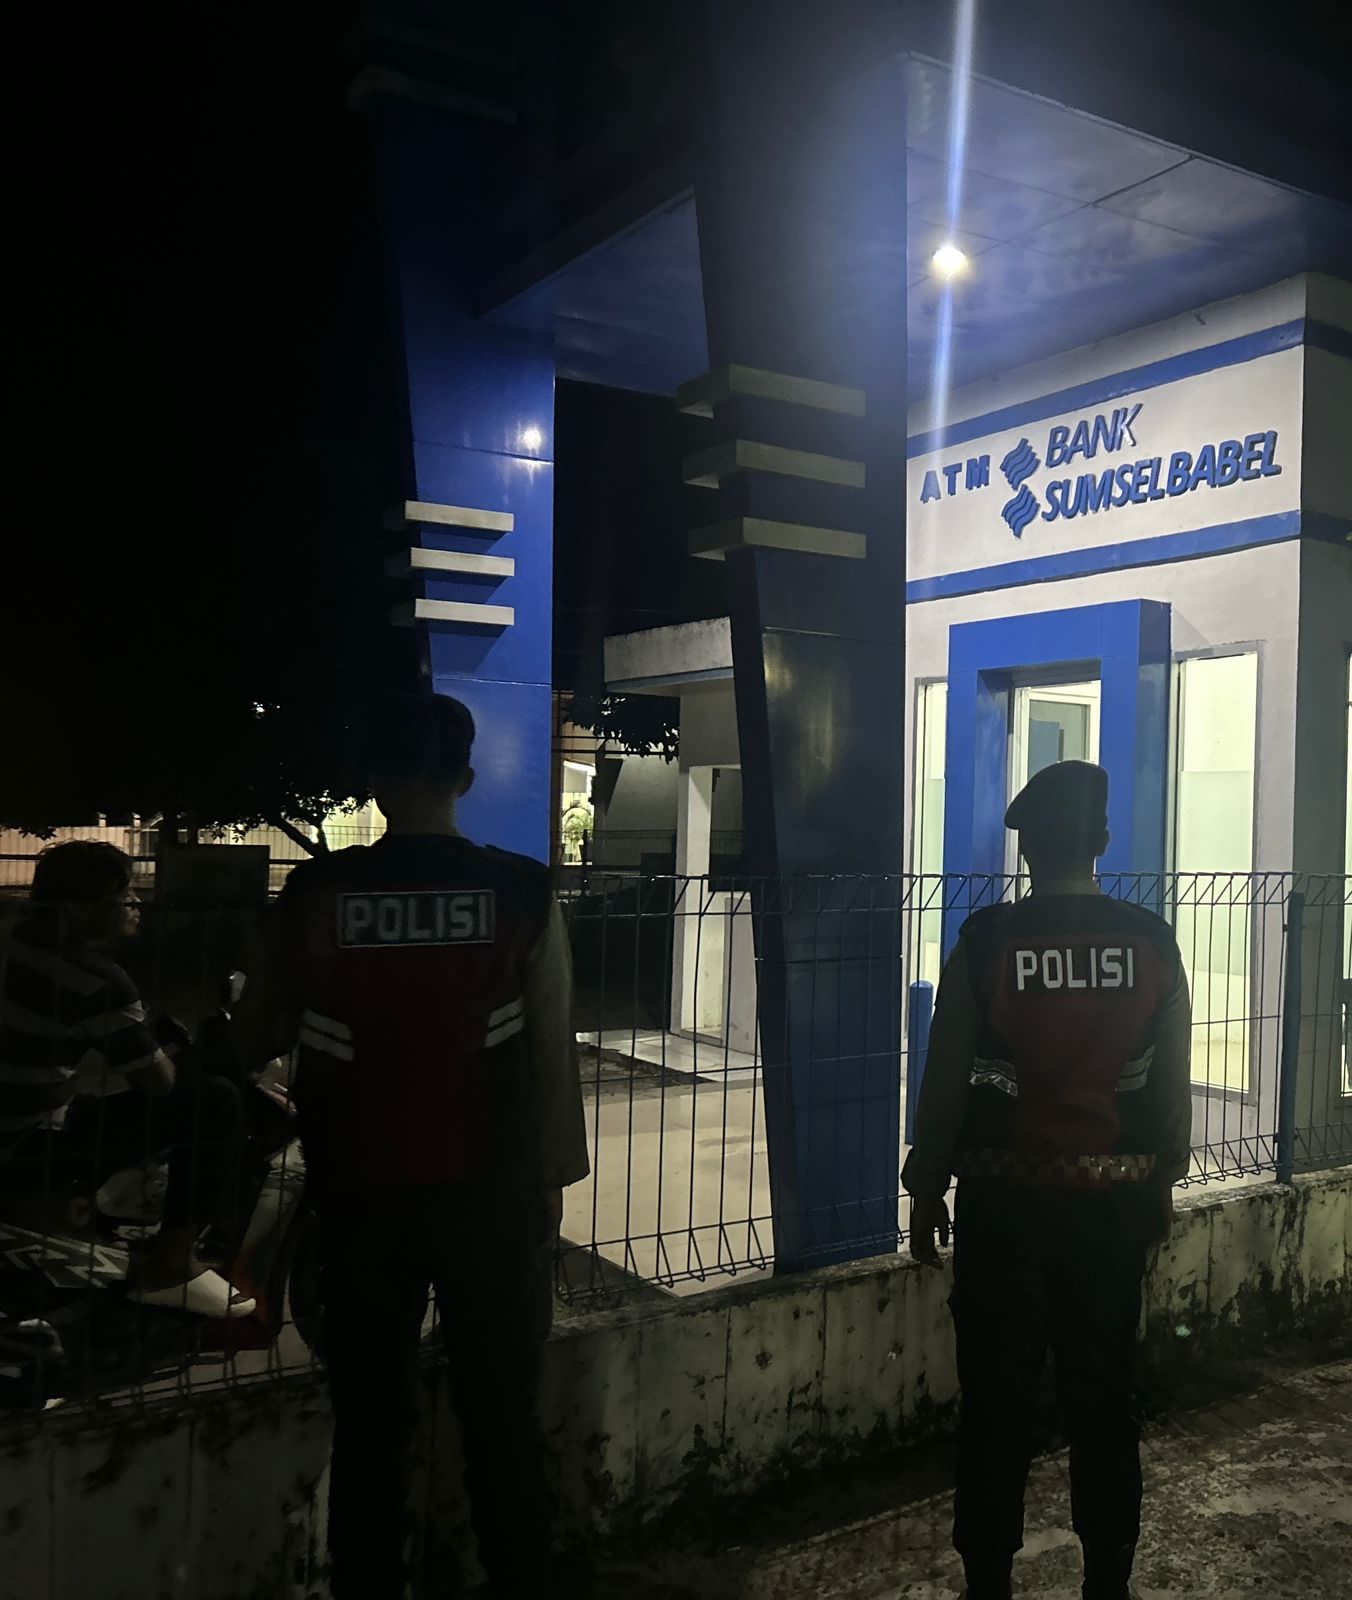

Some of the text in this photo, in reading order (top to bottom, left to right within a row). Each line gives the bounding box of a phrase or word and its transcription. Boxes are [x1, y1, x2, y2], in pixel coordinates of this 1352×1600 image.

[1045, 403, 1143, 469] BANK
[920, 455, 991, 504] ATM
[1041, 430, 1282, 523] SUMSELBABEL
[345, 895, 489, 942] POLISI
[1015, 947, 1134, 991] POLISI
